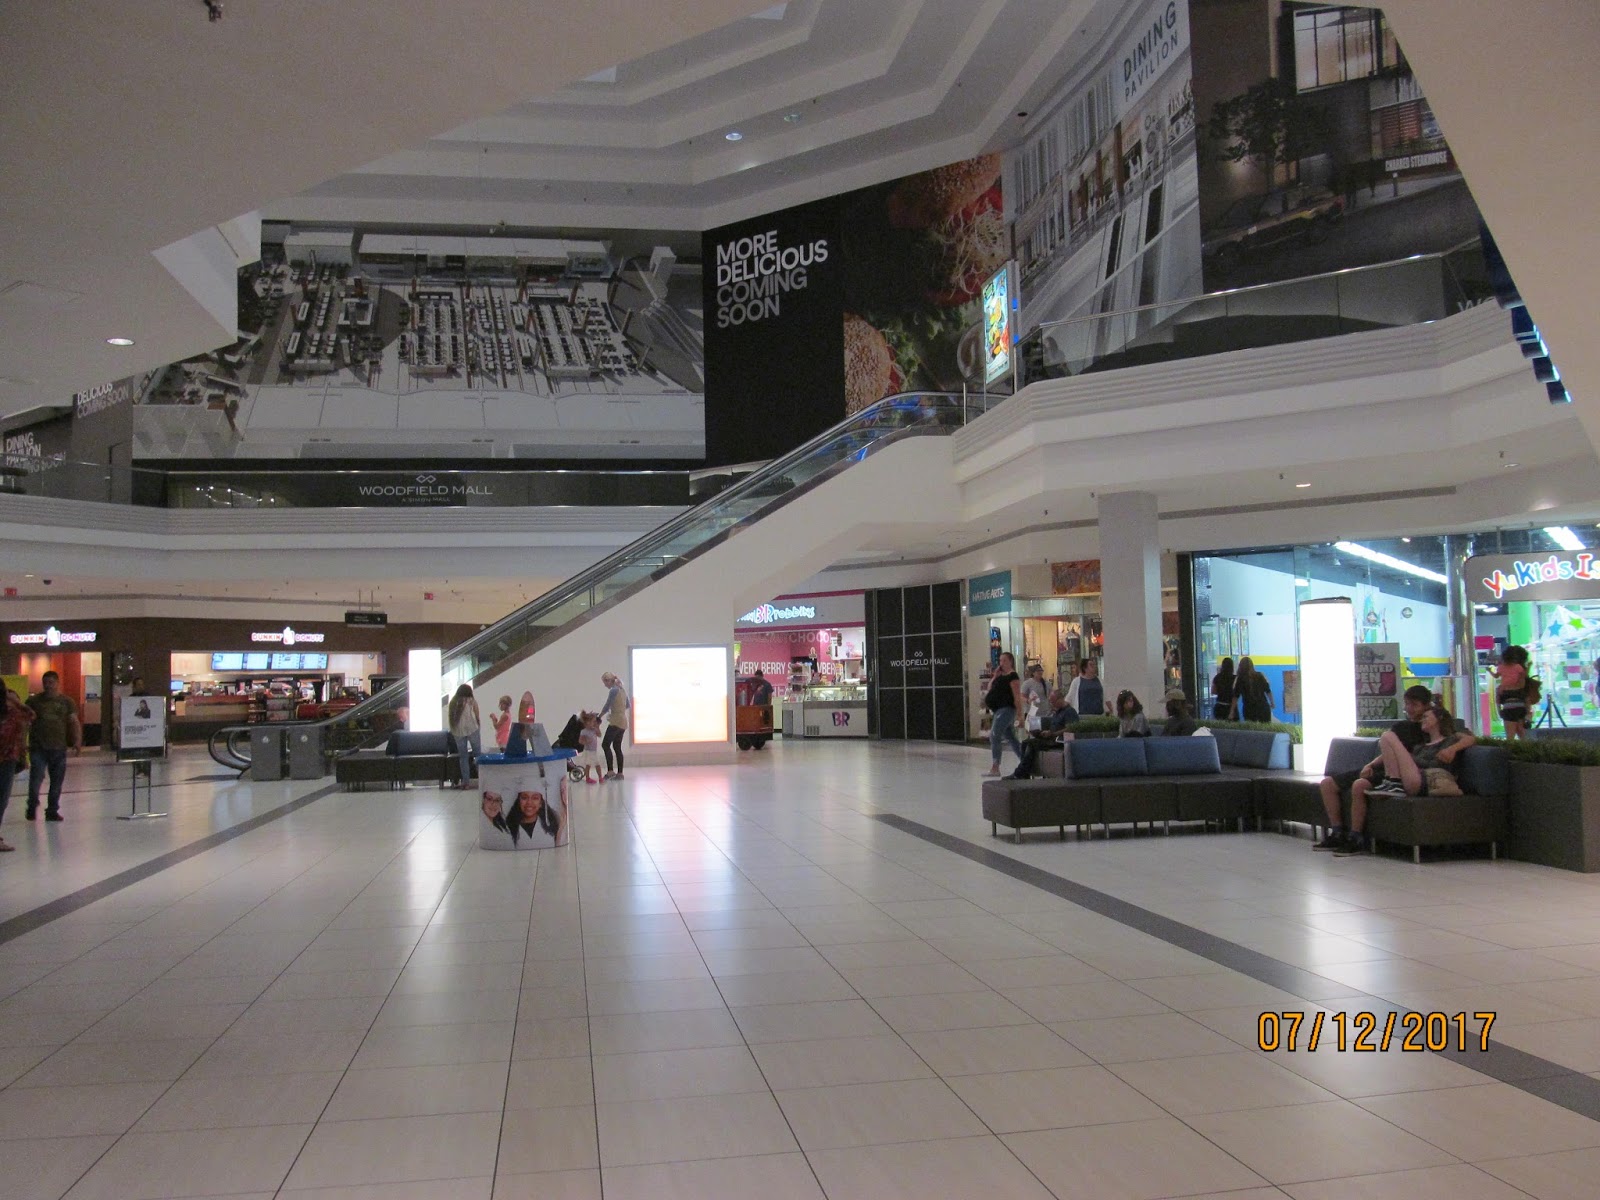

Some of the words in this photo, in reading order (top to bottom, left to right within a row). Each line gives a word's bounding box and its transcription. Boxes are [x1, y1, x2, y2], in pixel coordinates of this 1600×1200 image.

[1124, 1, 1177, 82] DINING
[1125, 30, 1178, 102] PAVILION
[717, 230, 778, 265] MORE
[717, 240, 828, 287] DELICIOUS
[717, 267, 807, 307] COMING
[718, 295, 779, 329] SOON
[359, 486, 449, 495] WOODFIELD
[452, 486, 493, 495] MALL
[60, 632, 96, 642] DONUTS
[294, 633, 325, 643] DONUTS
[761, 661, 785, 675] BERRY
[890, 659, 929, 667] WOODFIELD
[930, 657, 950, 665] MALL
[832, 711, 850, 726] BR
